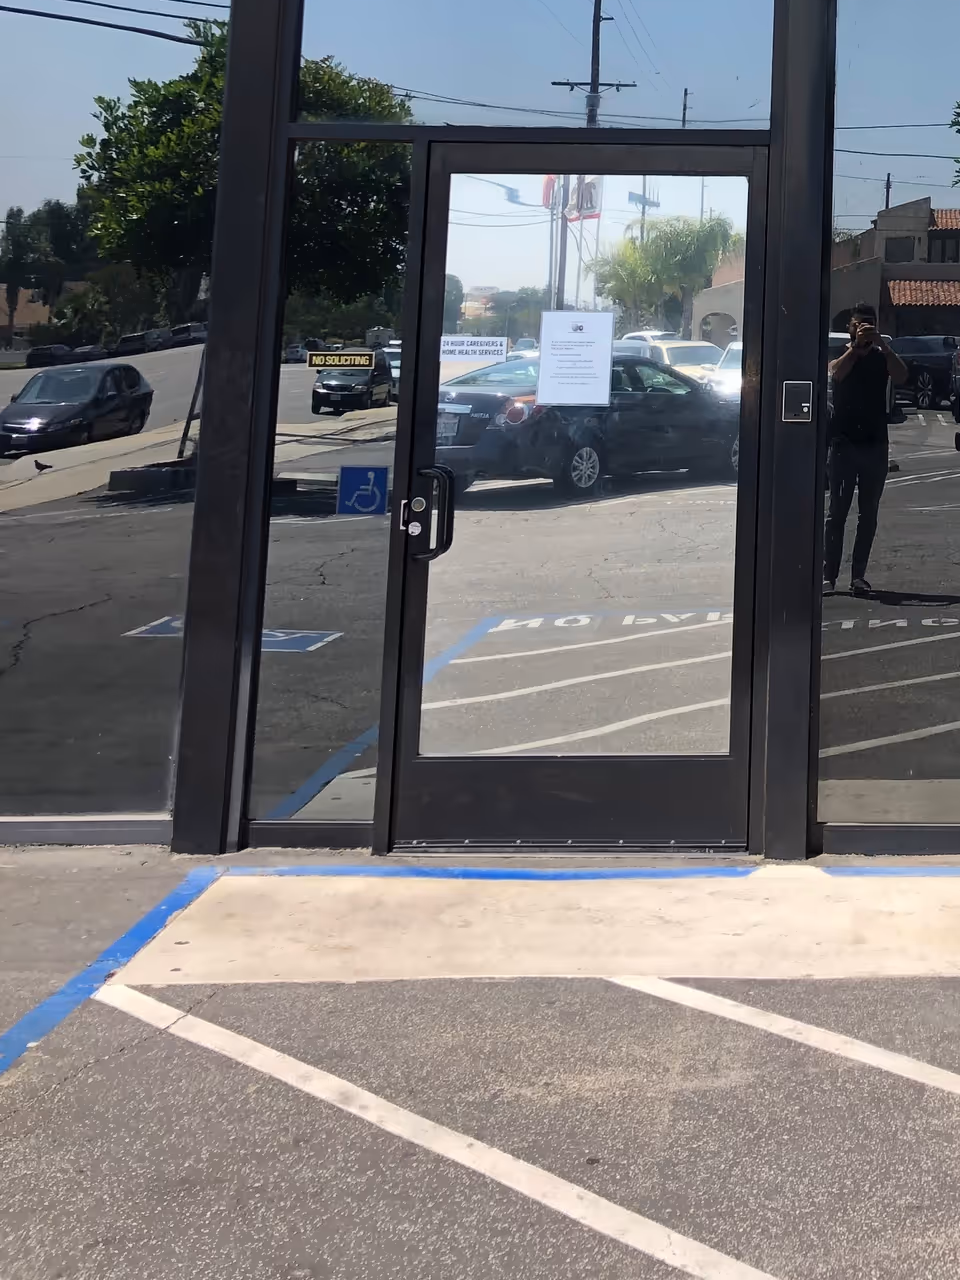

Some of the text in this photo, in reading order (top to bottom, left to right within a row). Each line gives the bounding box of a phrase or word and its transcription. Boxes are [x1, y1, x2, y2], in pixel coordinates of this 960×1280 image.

[466, 340, 498, 348] CAREGIVERS
[312, 355, 370, 365] NO SOLICITING
